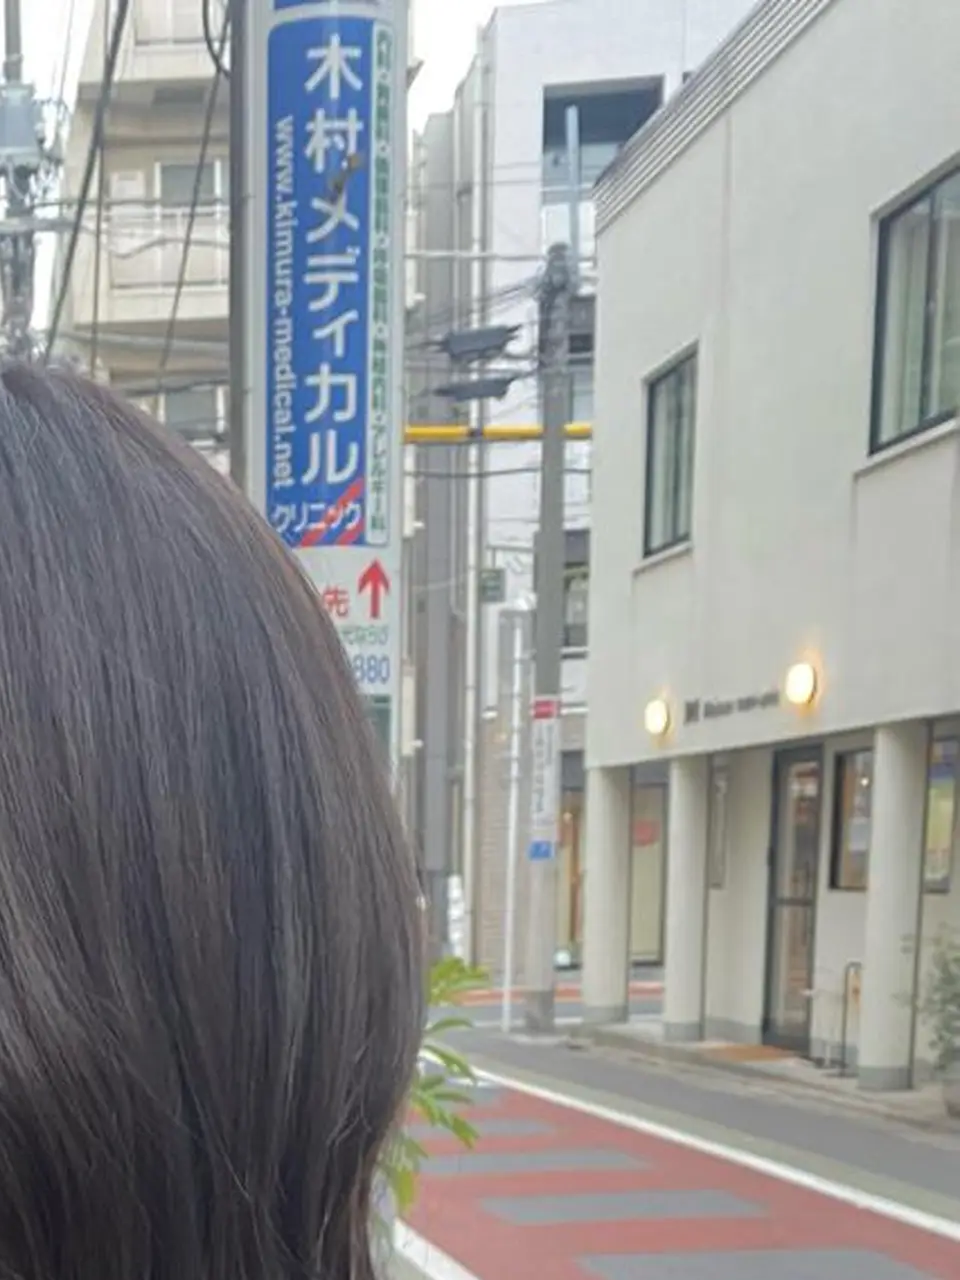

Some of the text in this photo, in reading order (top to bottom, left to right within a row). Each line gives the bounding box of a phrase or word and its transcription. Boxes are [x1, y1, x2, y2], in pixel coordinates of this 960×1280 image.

[272, 114, 298, 489] www.kimura-medical.net
[301, 32, 364, 486] 木村メディカル
[270, 501, 361, 533] クリニック
